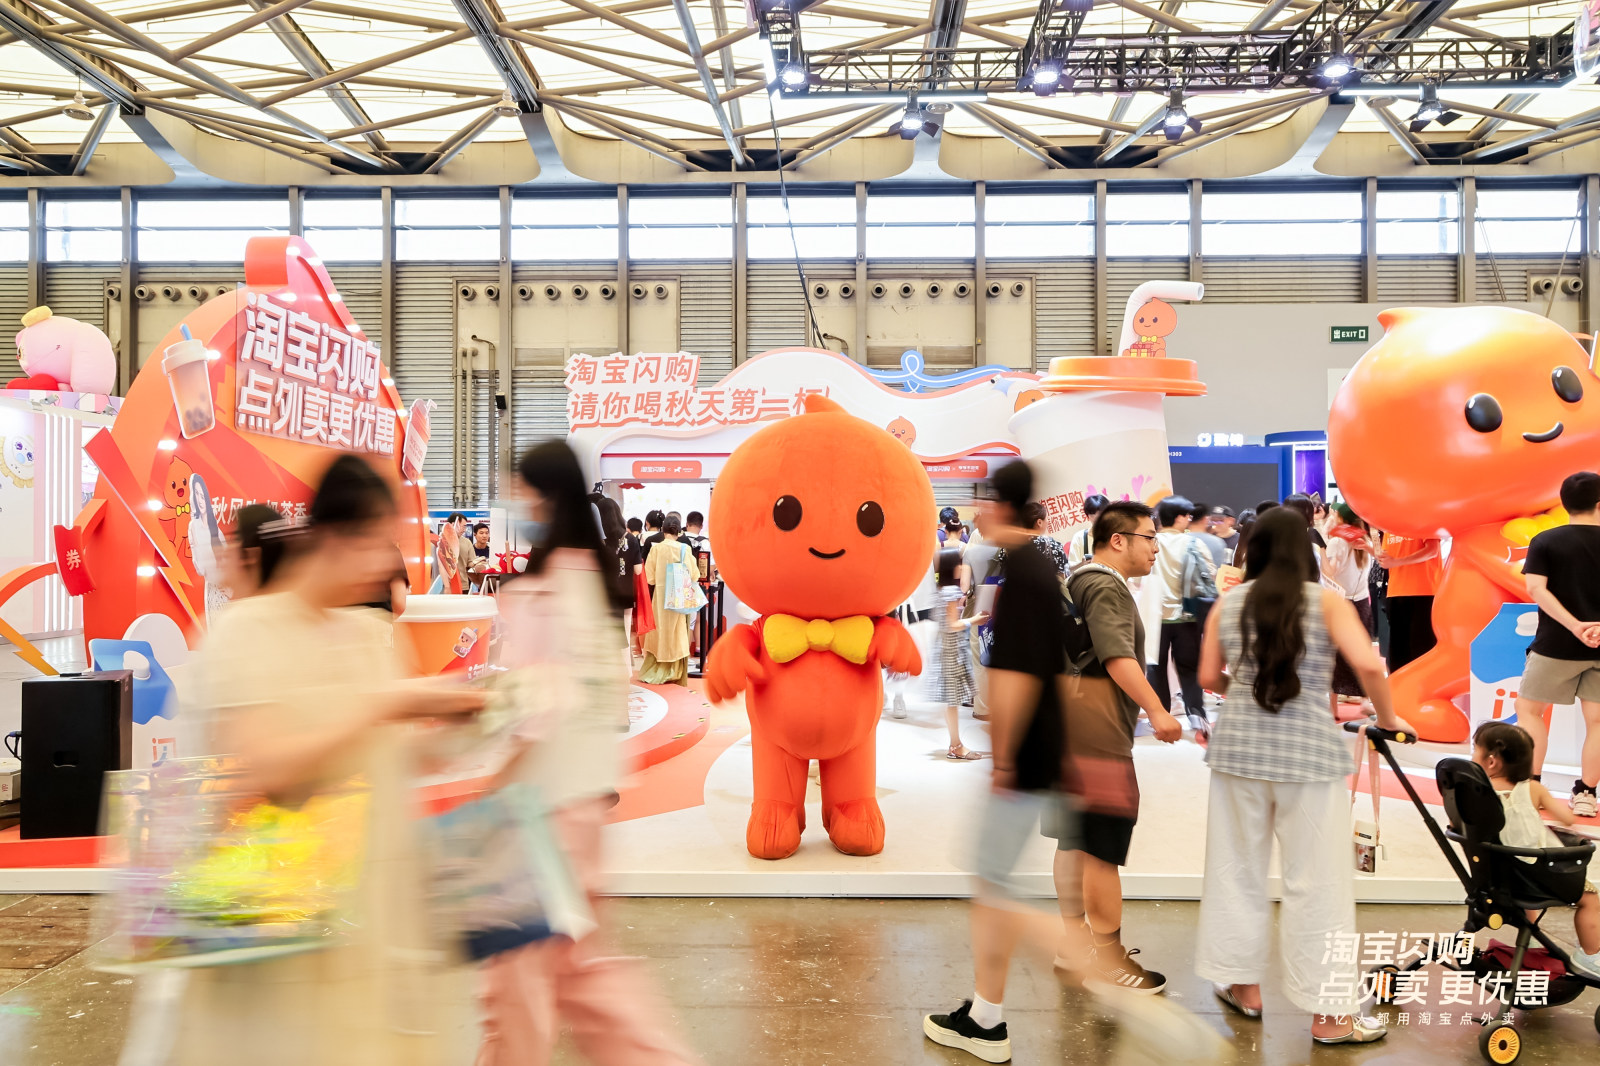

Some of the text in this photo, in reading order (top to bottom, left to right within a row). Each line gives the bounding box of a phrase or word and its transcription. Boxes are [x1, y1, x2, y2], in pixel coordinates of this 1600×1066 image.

[241, 292, 381, 400] 淘宝闪购
[569, 355, 694, 385] 淘宝闪购
[238, 369, 396, 454] 点外卖更优惠
[66, 549, 81, 570] 券
